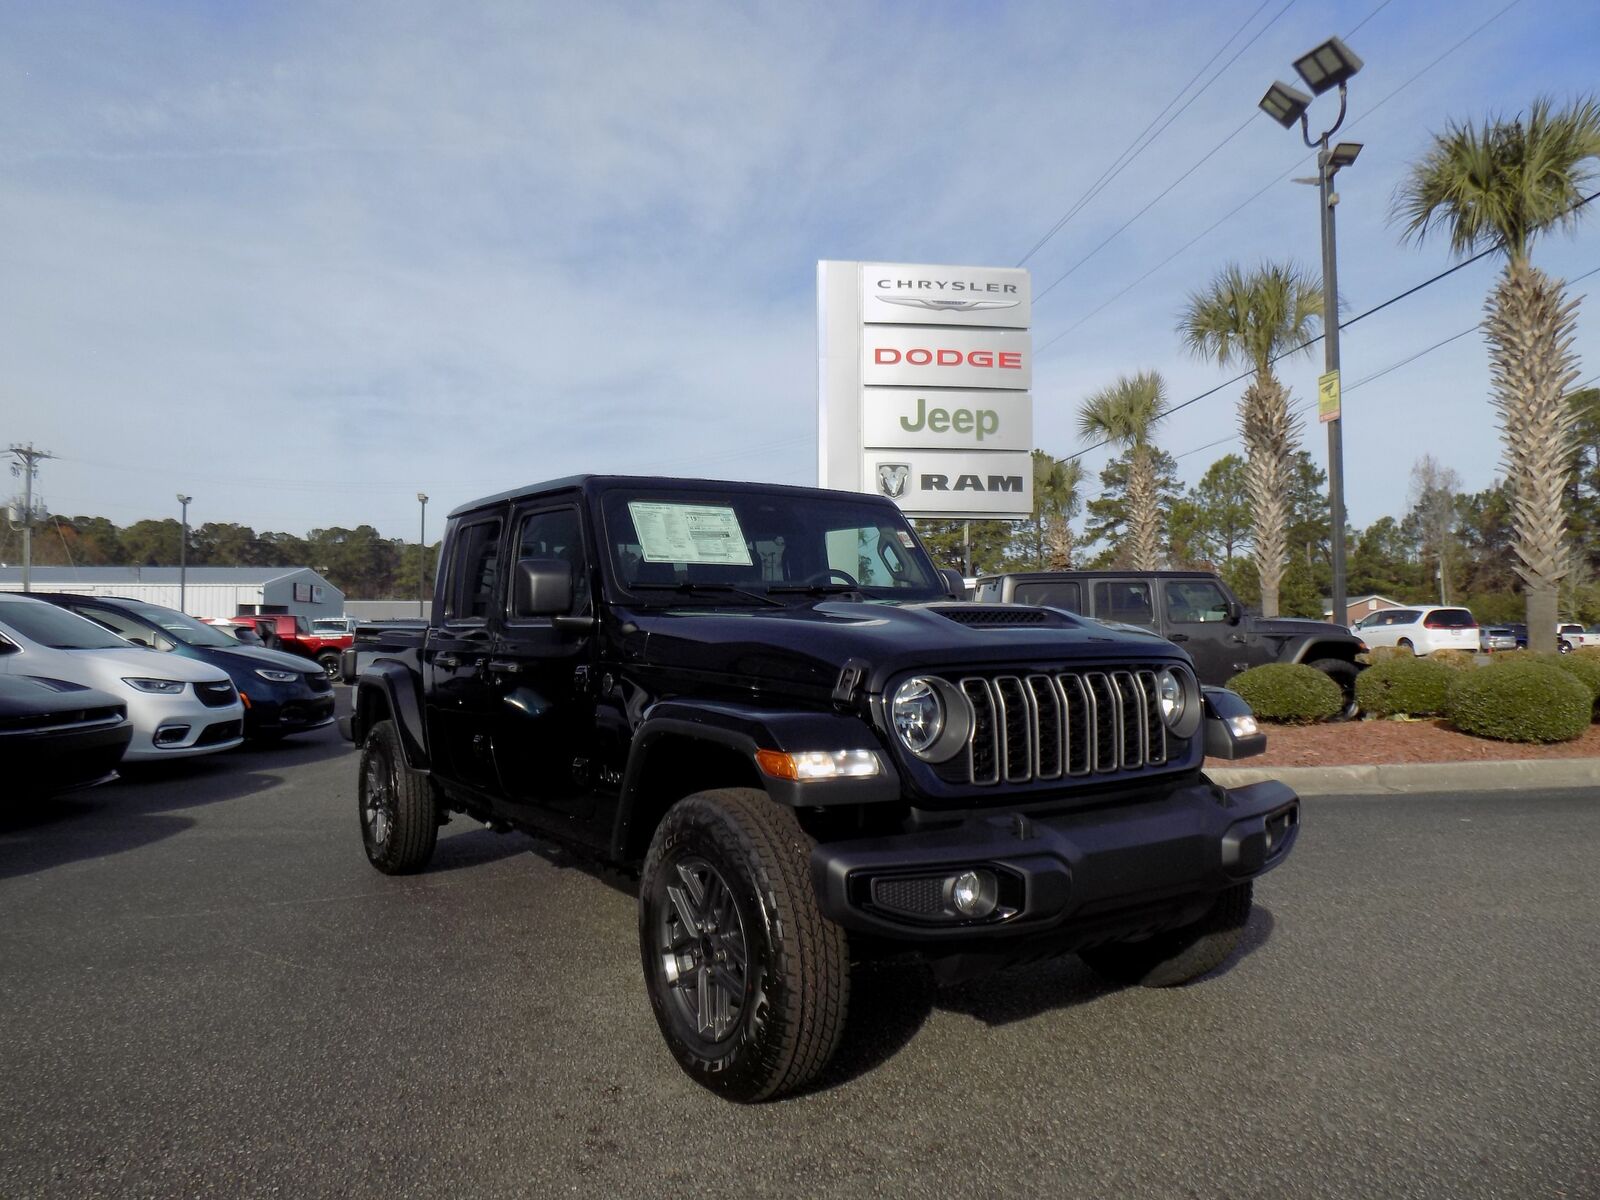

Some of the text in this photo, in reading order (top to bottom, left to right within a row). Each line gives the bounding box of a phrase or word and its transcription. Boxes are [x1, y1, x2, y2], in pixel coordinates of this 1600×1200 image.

[877, 279, 1018, 294] CHRYSLER
[874, 348, 1022, 369] DODGE
[900, 398, 999, 441] Jeep
[921, 474, 1023, 492] RAM
